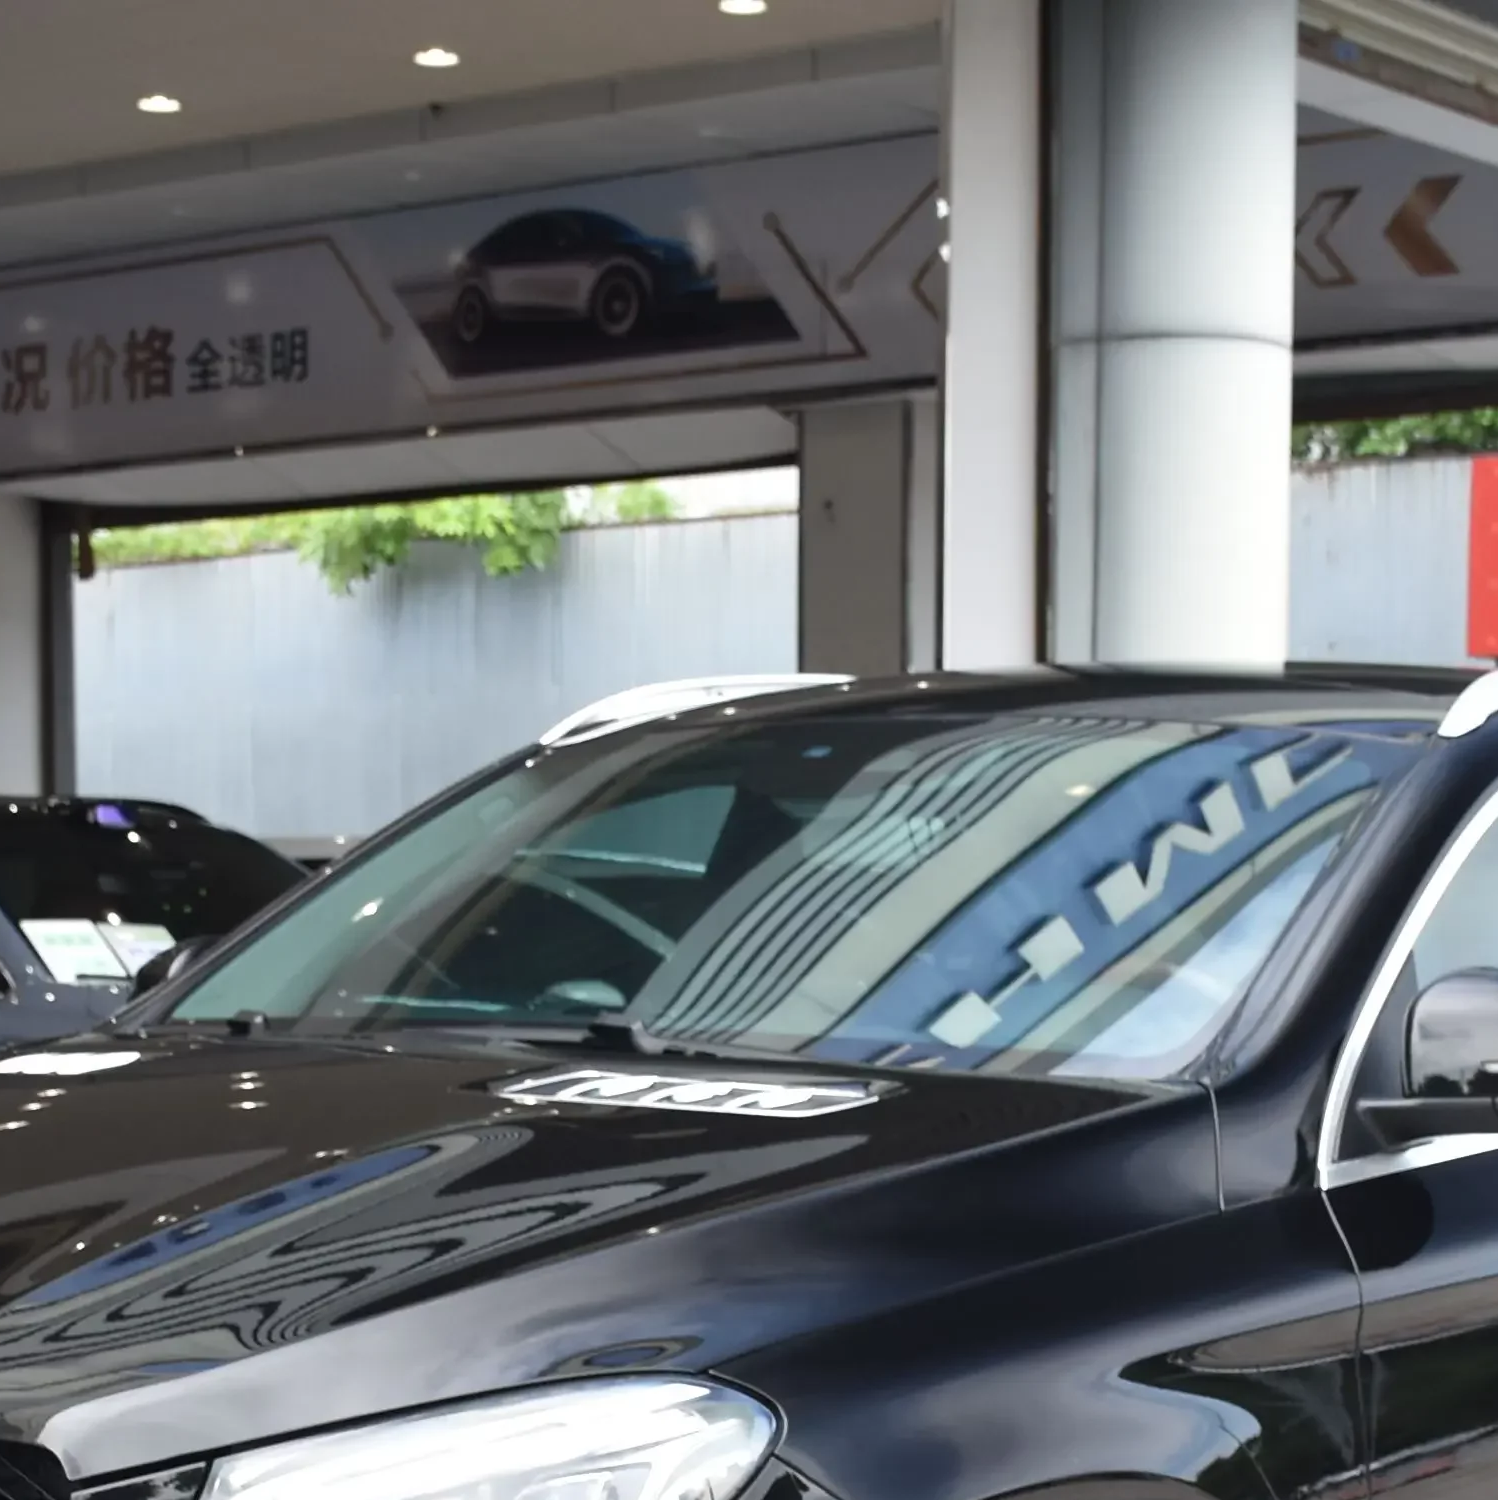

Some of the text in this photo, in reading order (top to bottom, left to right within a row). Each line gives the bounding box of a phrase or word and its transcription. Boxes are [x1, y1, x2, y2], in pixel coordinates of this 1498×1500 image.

[66, 323, 177, 409] 价格
[185, 327, 311, 393] 全透明
